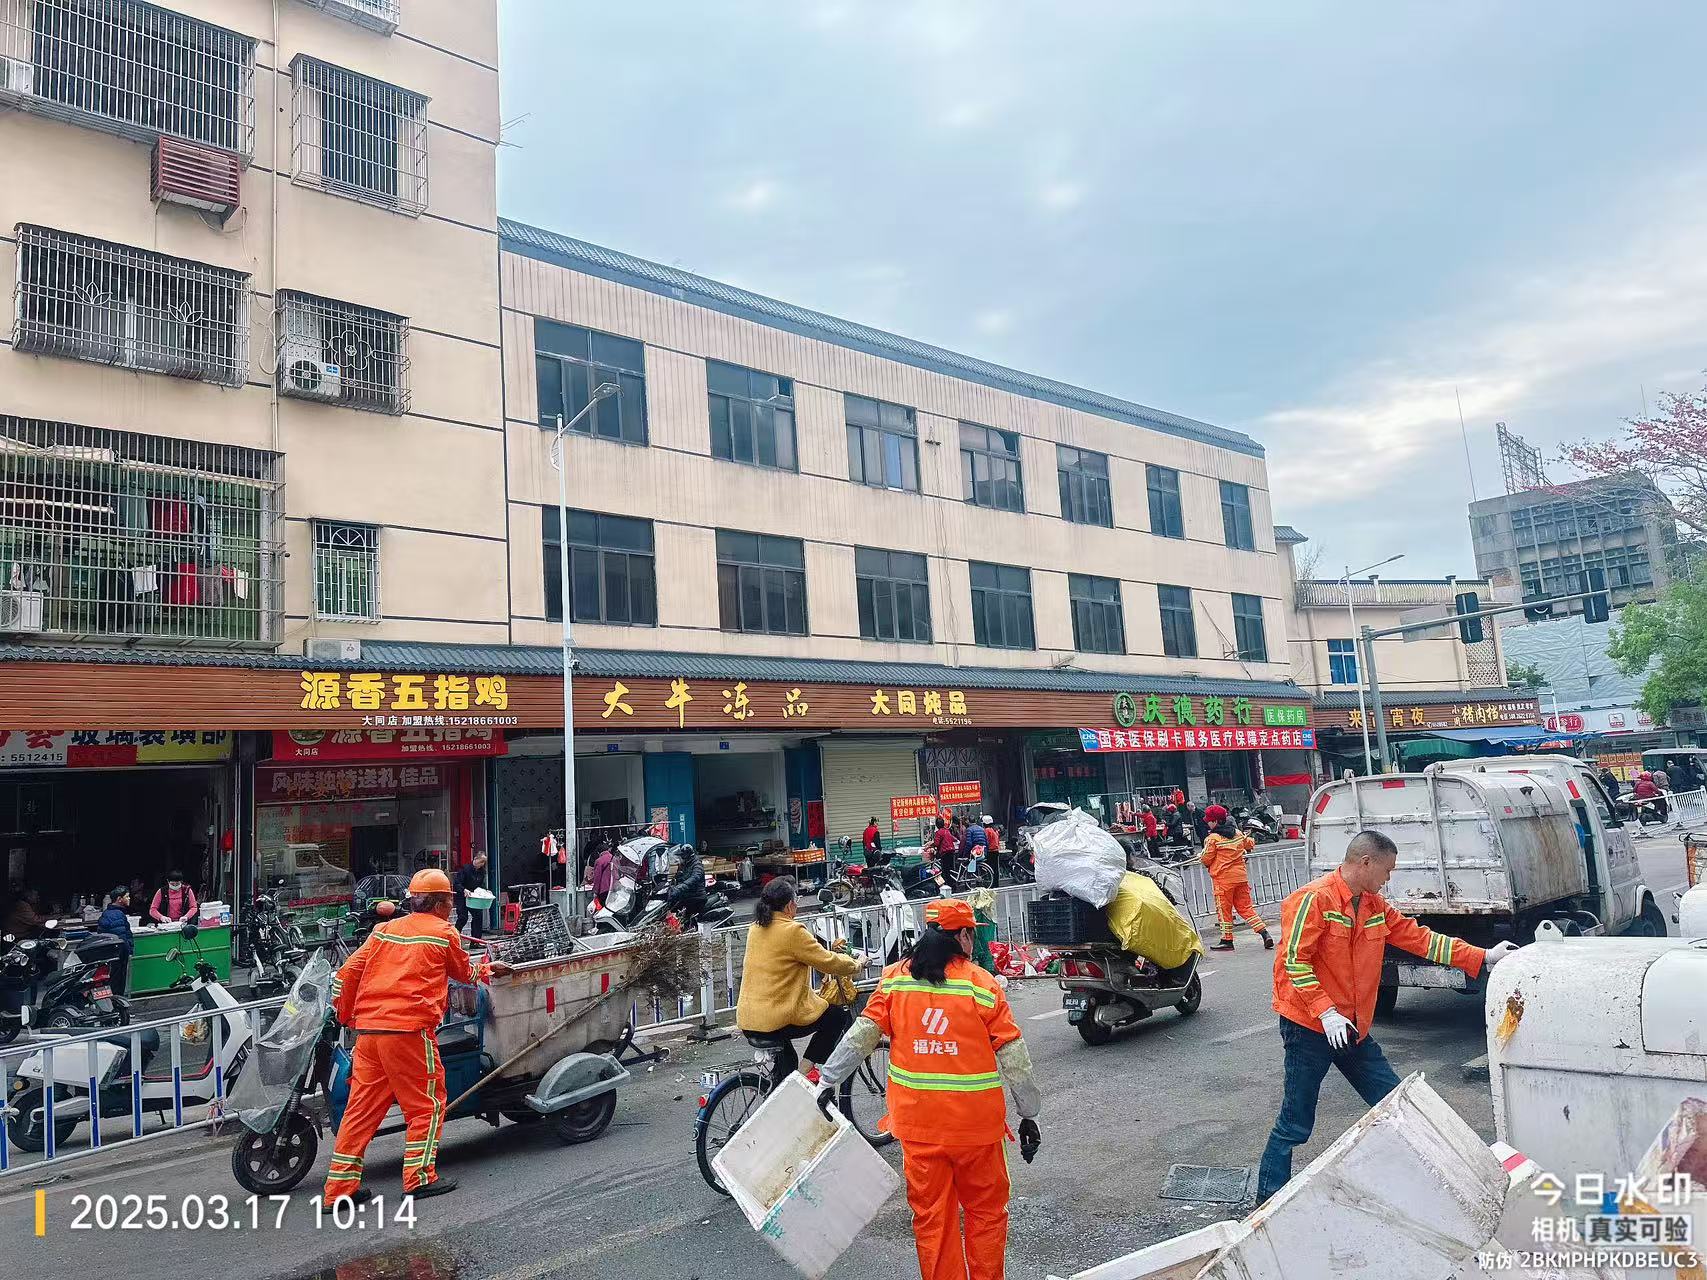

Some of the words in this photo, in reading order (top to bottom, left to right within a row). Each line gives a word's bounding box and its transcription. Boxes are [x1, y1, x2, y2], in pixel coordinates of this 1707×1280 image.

[300, 671, 508, 710] 源香五指鸡
[602, 677, 809, 728] 大牛冻品
[1142, 693, 1252, 726] 庆德药行
[361, 715, 398, 727] 大同店
[402, 715, 518, 727] 加盟热线:15218661003
[1266, 708, 1304, 724] 医保药房
[1099, 728, 1302, 749] 国家医保刷卡服务医疗保障定点药店
[10, 753, 63, 762] 5512415
[295, 748, 318, 757] 大同店
[913, 1039, 959, 1055] 福龙马
